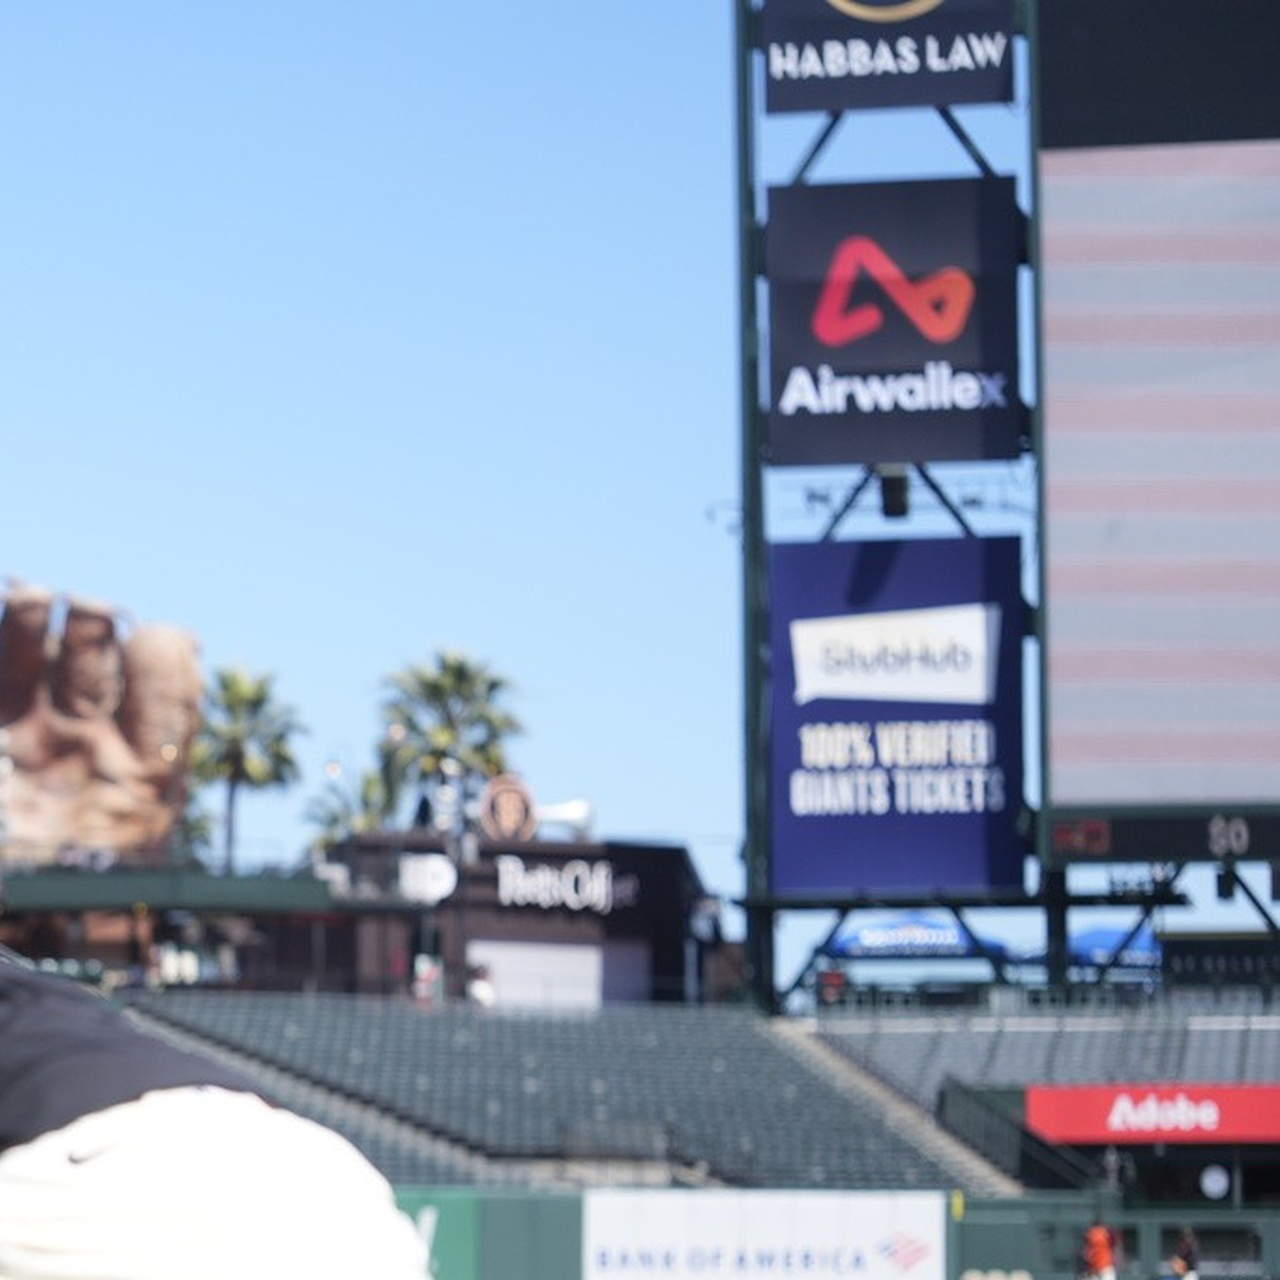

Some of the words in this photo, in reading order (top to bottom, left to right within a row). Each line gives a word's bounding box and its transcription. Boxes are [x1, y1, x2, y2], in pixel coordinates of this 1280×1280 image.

[925, 31, 1007, 73] LAW
[779, 362, 1005, 416] Airwallex
[820, 637, 973, 680] StubHub
[1106, 1092, 1221, 1132] Adobe
[594, 1248, 676, 1273] BANK
[685, 1248, 722, 1273] OF
[735, 1246, 868, 1273] AMERICA
